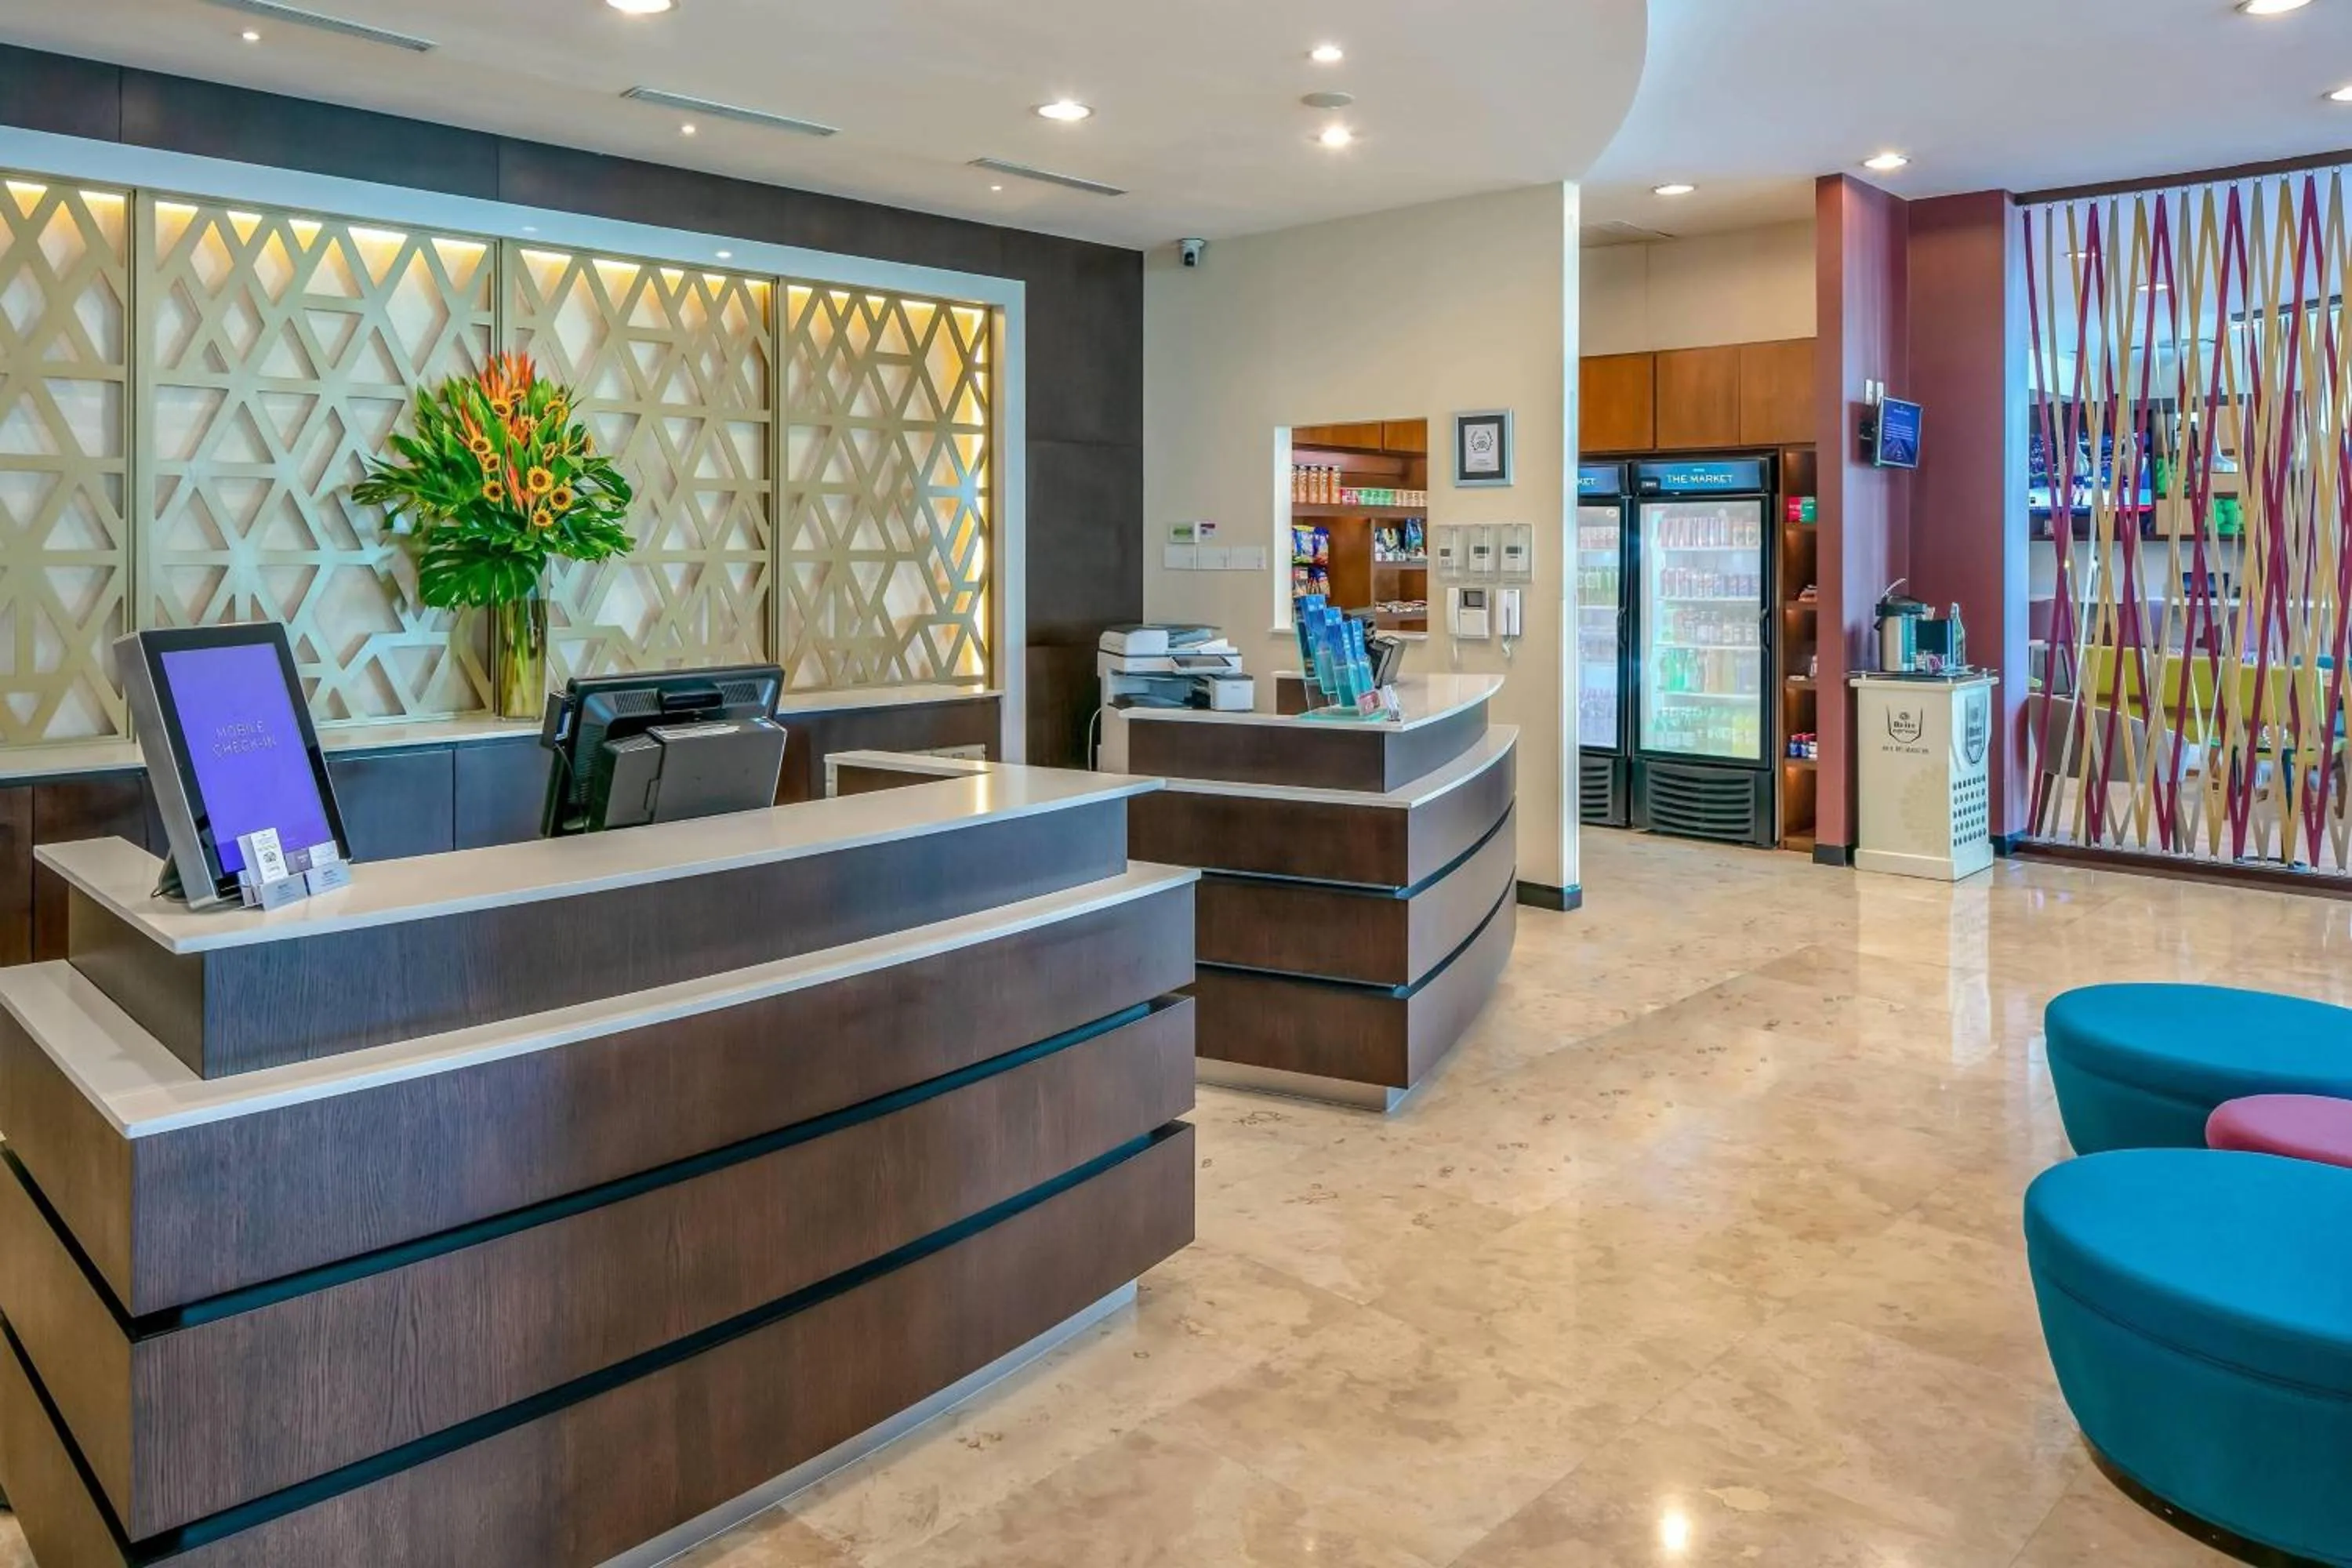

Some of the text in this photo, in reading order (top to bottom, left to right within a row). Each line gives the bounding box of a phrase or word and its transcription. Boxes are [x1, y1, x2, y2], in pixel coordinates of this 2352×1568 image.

[1667, 474, 1733, 485] THE MARKET
[215, 720, 264, 737] MOBILE
[212, 735, 277, 754] CHECK-IN
